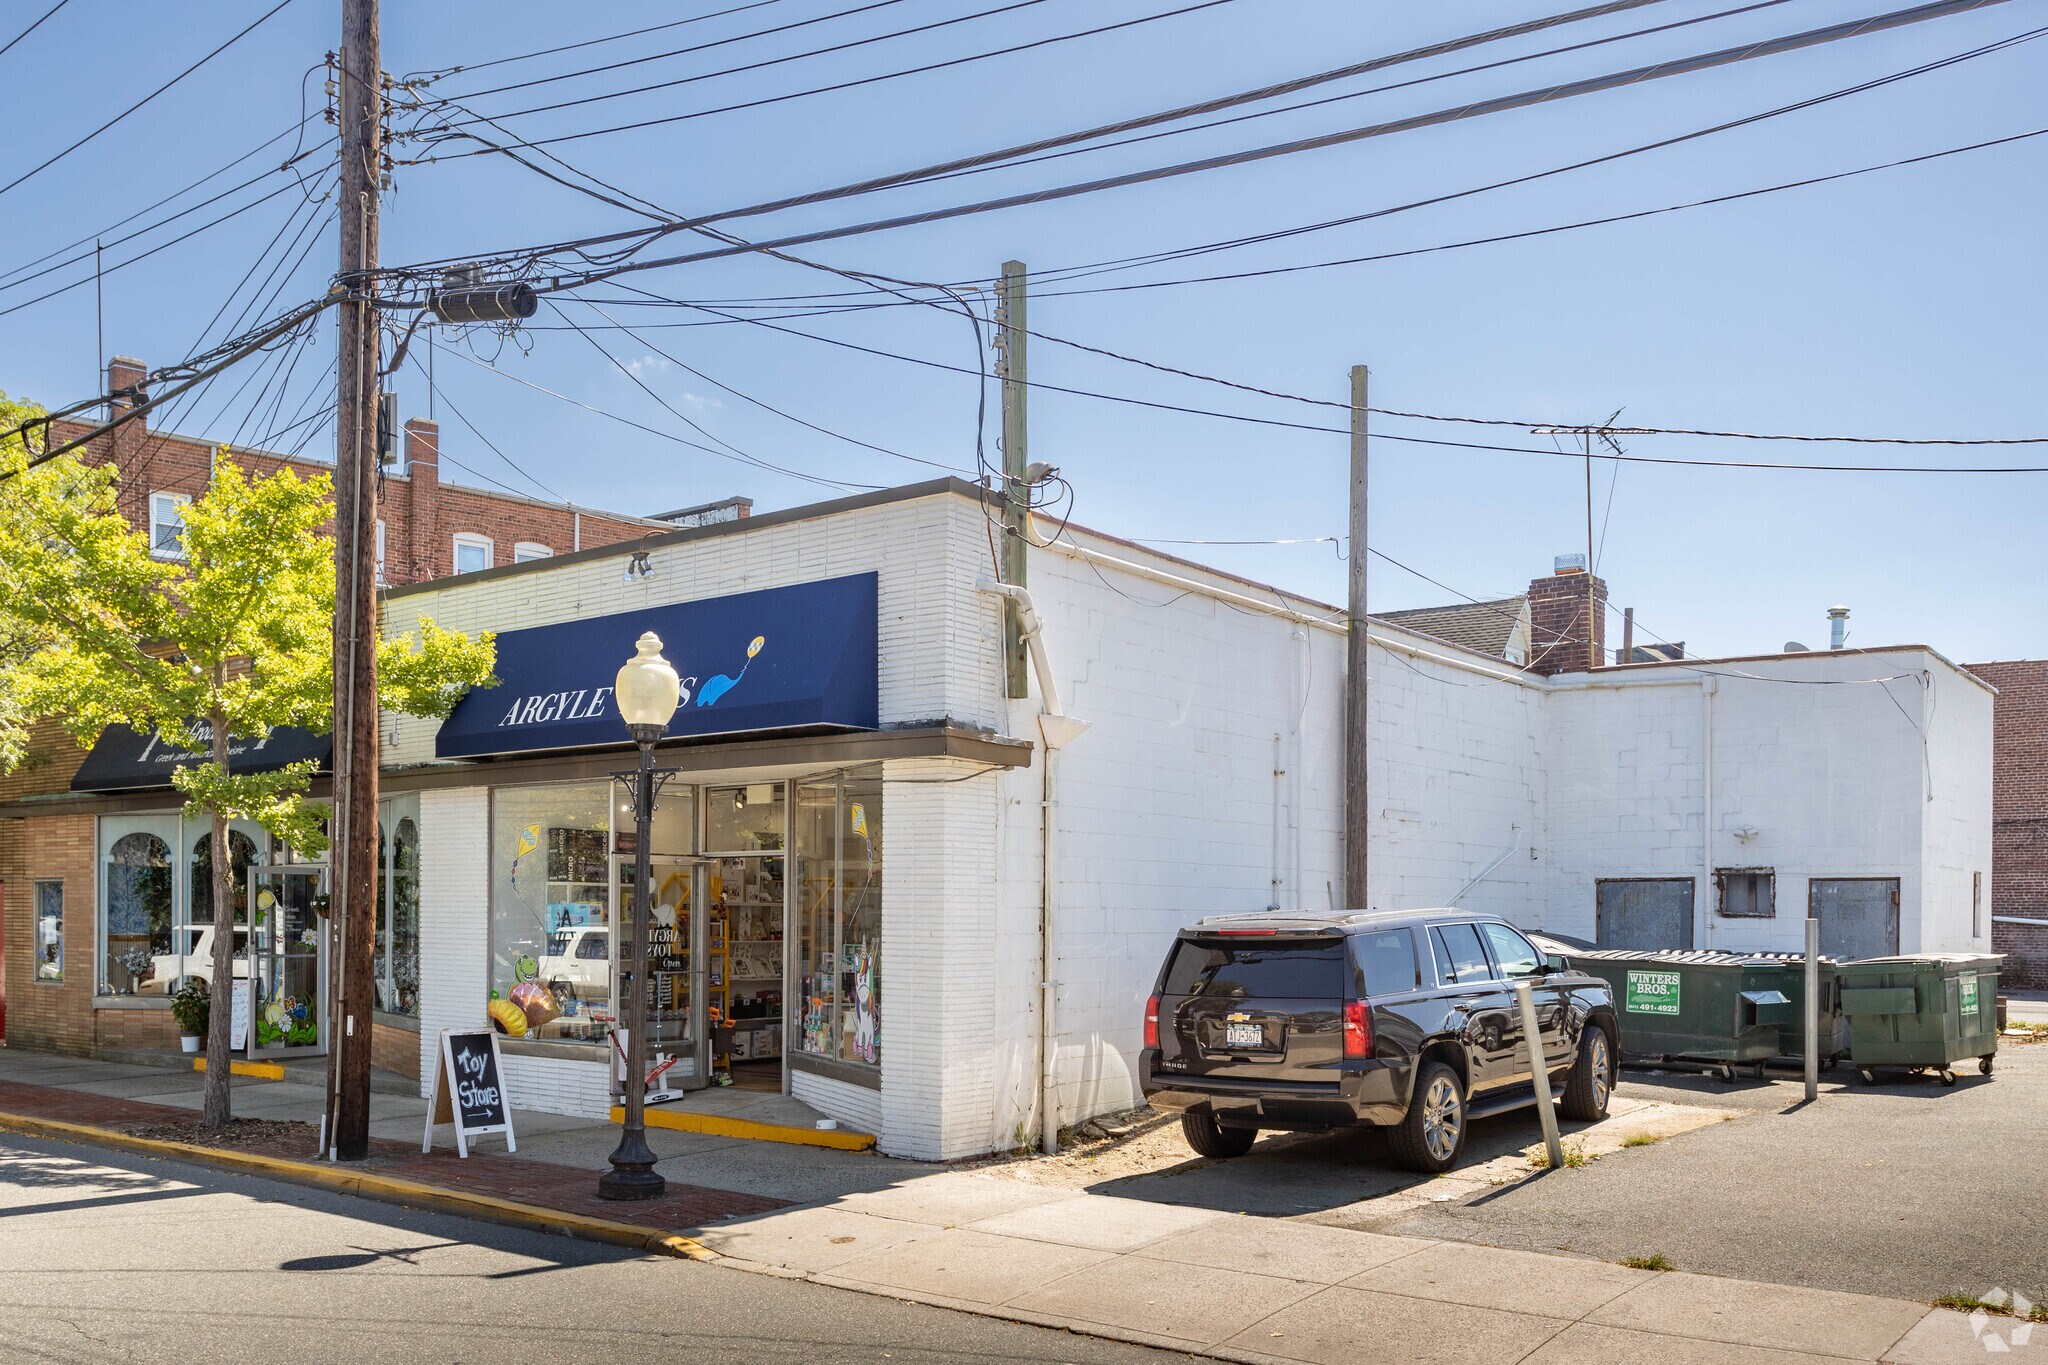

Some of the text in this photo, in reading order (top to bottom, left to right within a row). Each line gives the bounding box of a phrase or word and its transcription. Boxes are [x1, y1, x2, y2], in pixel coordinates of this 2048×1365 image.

[498, 686, 614, 727] ARGYLE
[662, 957, 681, 971] Open
[1629, 973, 1679, 985] WINTERS
[1636, 983, 1670, 995] BROS.
[457, 1046, 489, 1083] Toy
[458, 1079, 500, 1109] Store
